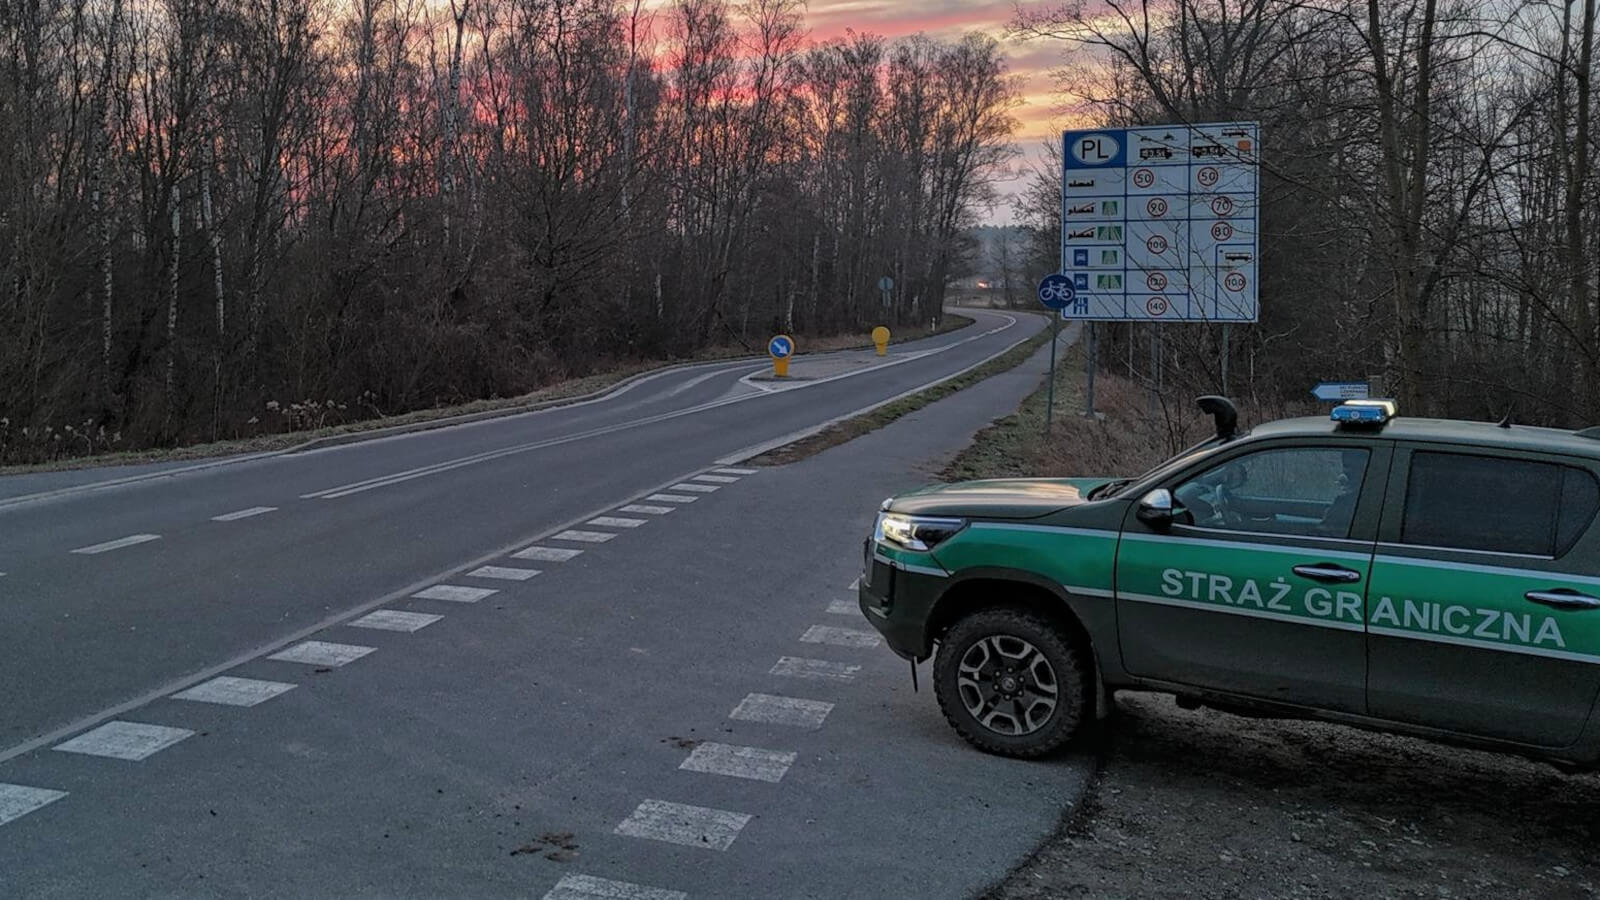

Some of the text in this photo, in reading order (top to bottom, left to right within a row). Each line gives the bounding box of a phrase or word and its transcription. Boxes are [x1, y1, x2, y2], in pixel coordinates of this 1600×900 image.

[1082, 139, 1109, 159] PL
[1137, 172, 1152, 183] 50
[1201, 171, 1216, 182] 50
[1150, 202, 1165, 213] 90
[1215, 200, 1229, 211] 70
[1214, 226, 1230, 237] 80
[1149, 241, 1167, 249] 100
[1228, 278, 1245, 287] 100
[1150, 302, 1165, 311] 140
[1161, 568, 1566, 648] STRAŻ GRANICZNA
